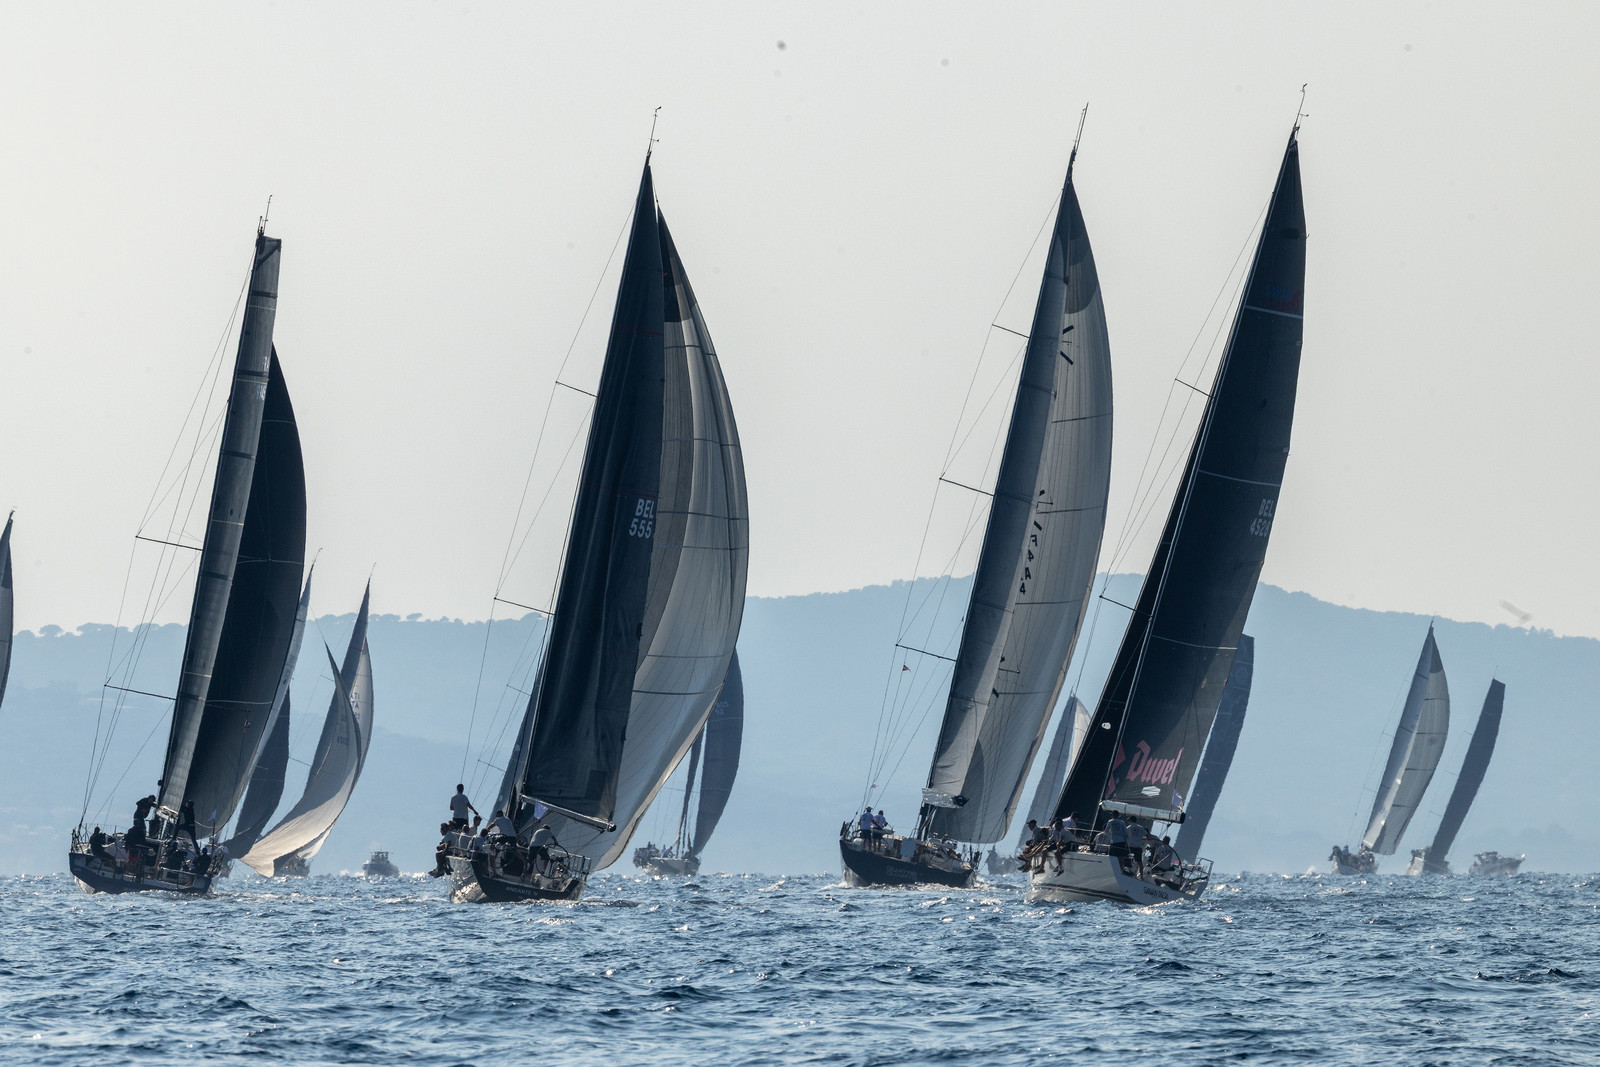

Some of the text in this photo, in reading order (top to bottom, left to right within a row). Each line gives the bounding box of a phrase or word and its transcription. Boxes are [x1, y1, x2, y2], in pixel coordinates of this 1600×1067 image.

[635, 498, 655, 519] BEL
[1258, 498, 1274, 518] BEL
[628, 518, 653, 539] 555
[1125, 739, 1184, 785] Duvel
